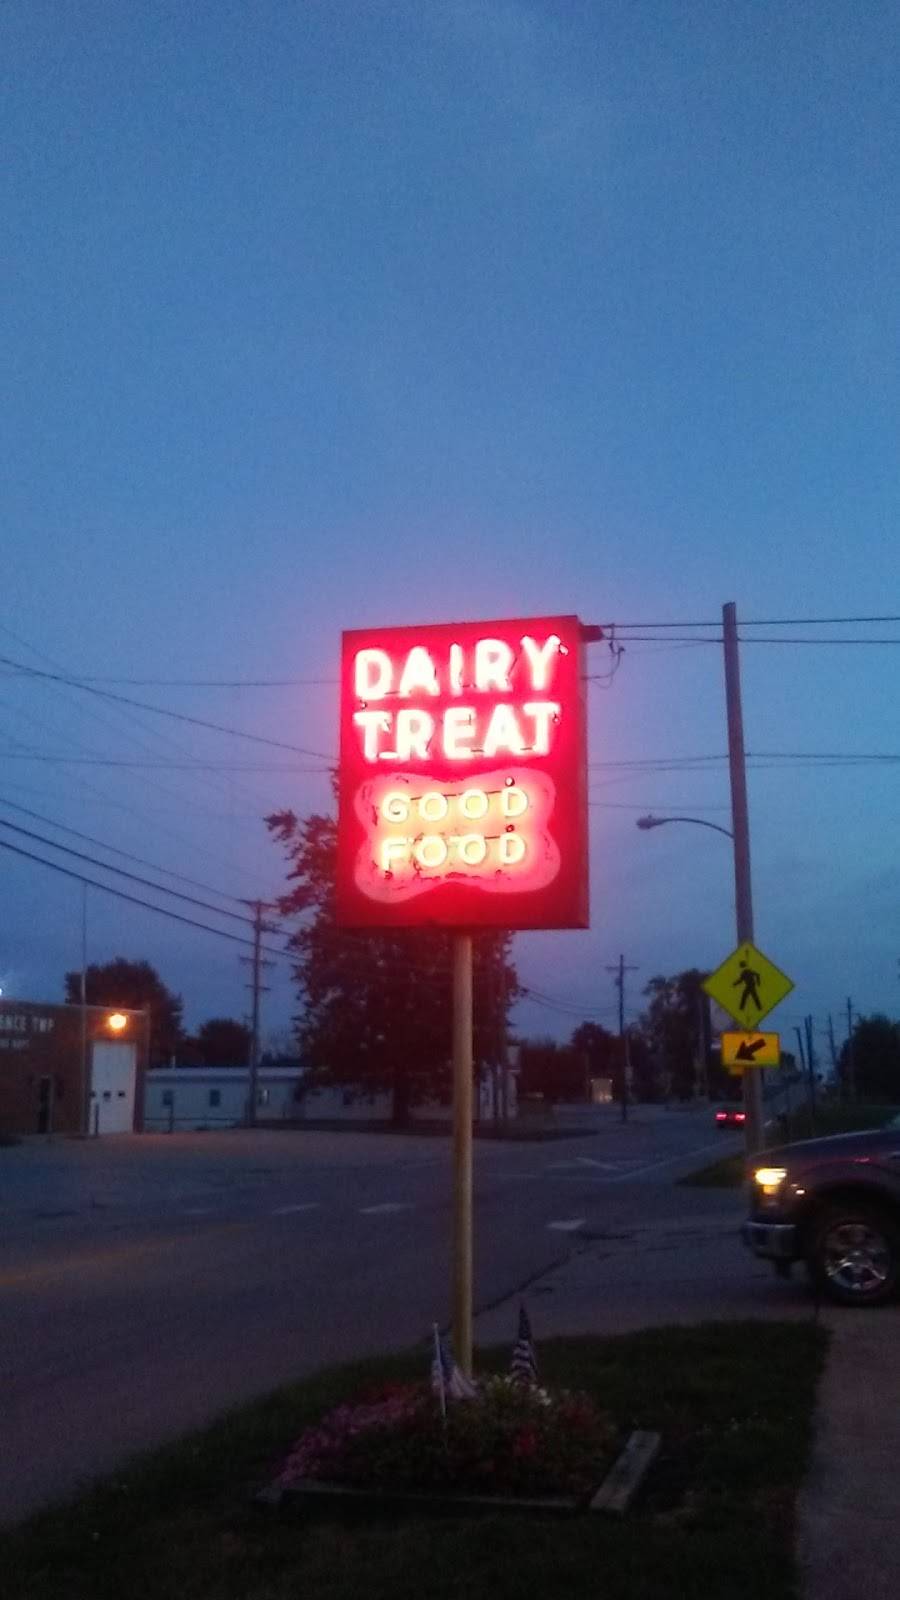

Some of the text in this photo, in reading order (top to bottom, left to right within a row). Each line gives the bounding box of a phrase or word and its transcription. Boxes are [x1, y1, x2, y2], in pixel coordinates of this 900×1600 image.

[354, 634, 561, 700] DAIRY
[353, 702, 561, 762] TREAT
[381, 786, 529, 823] GOOD
[381, 833, 527, 871] FOOD
